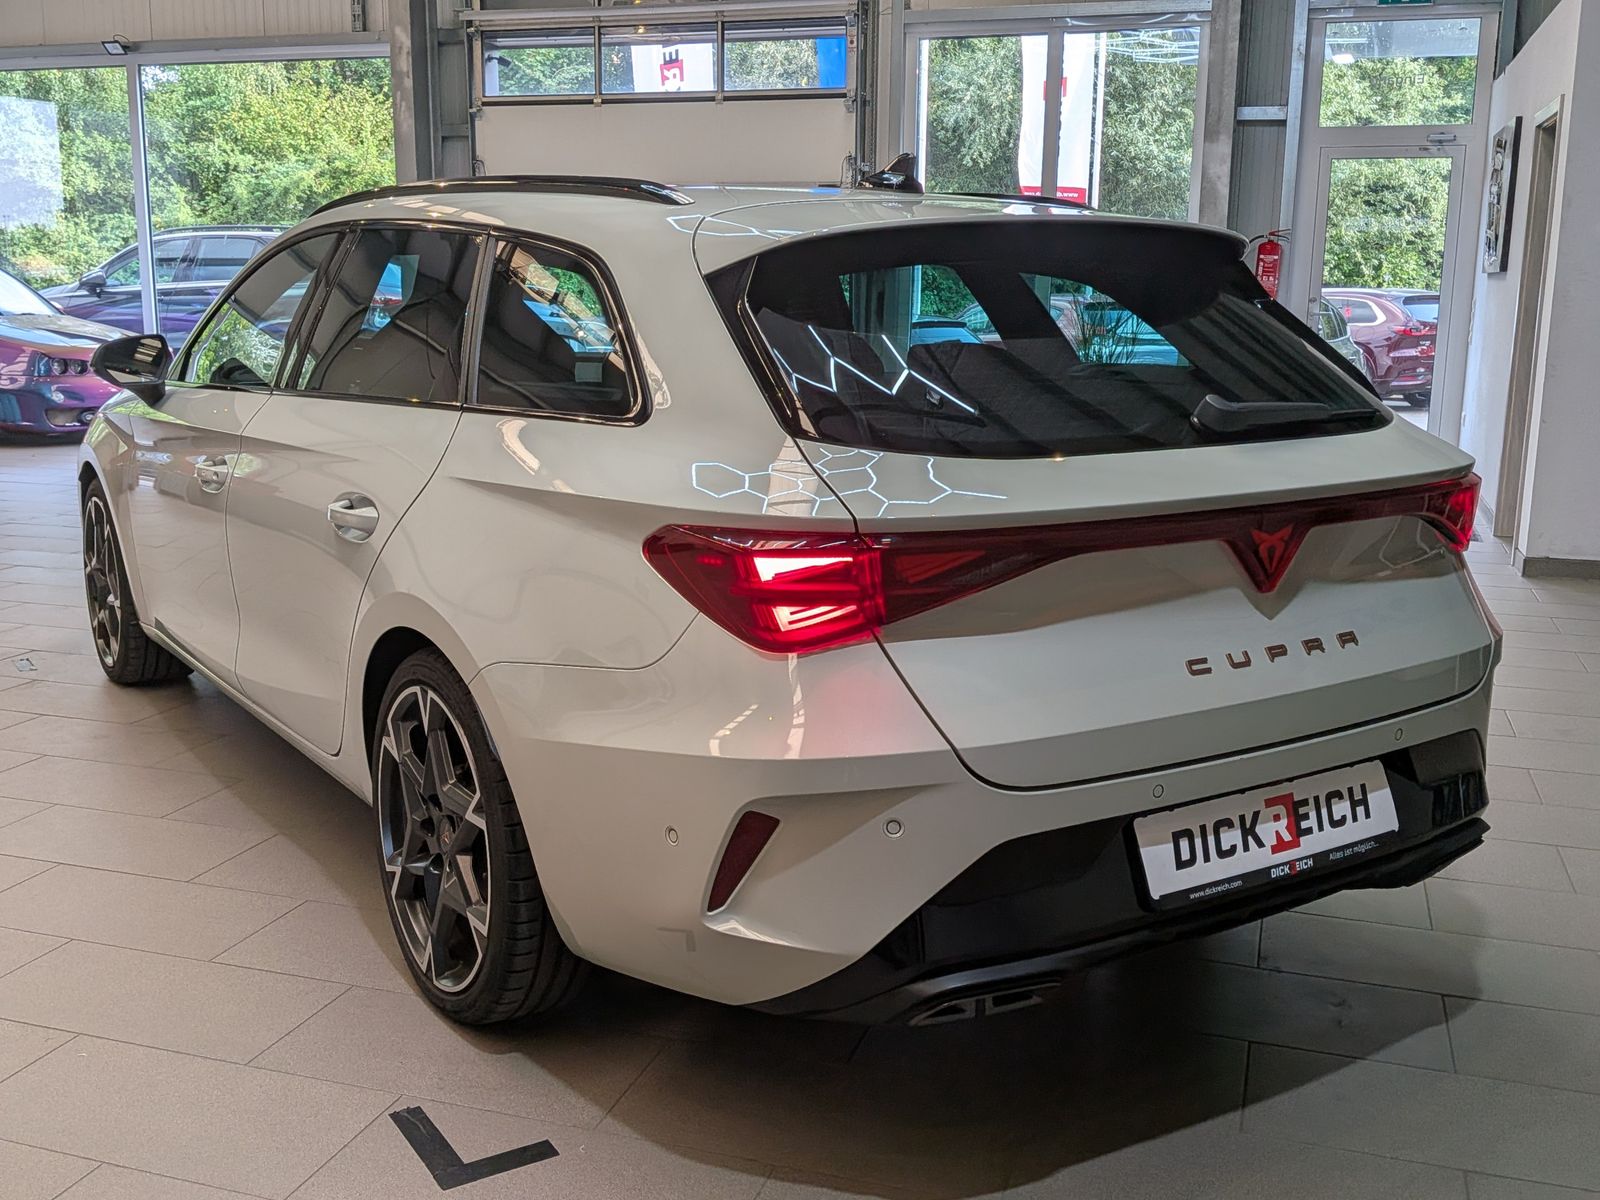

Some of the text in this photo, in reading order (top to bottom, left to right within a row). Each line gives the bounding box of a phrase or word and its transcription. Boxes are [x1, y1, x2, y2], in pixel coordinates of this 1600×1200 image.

[1185, 630, 1360, 677] CUPRA
[1171, 783, 1371, 872] DICKREICH
[1189, 880, 1243, 899] www.dickreich.com
